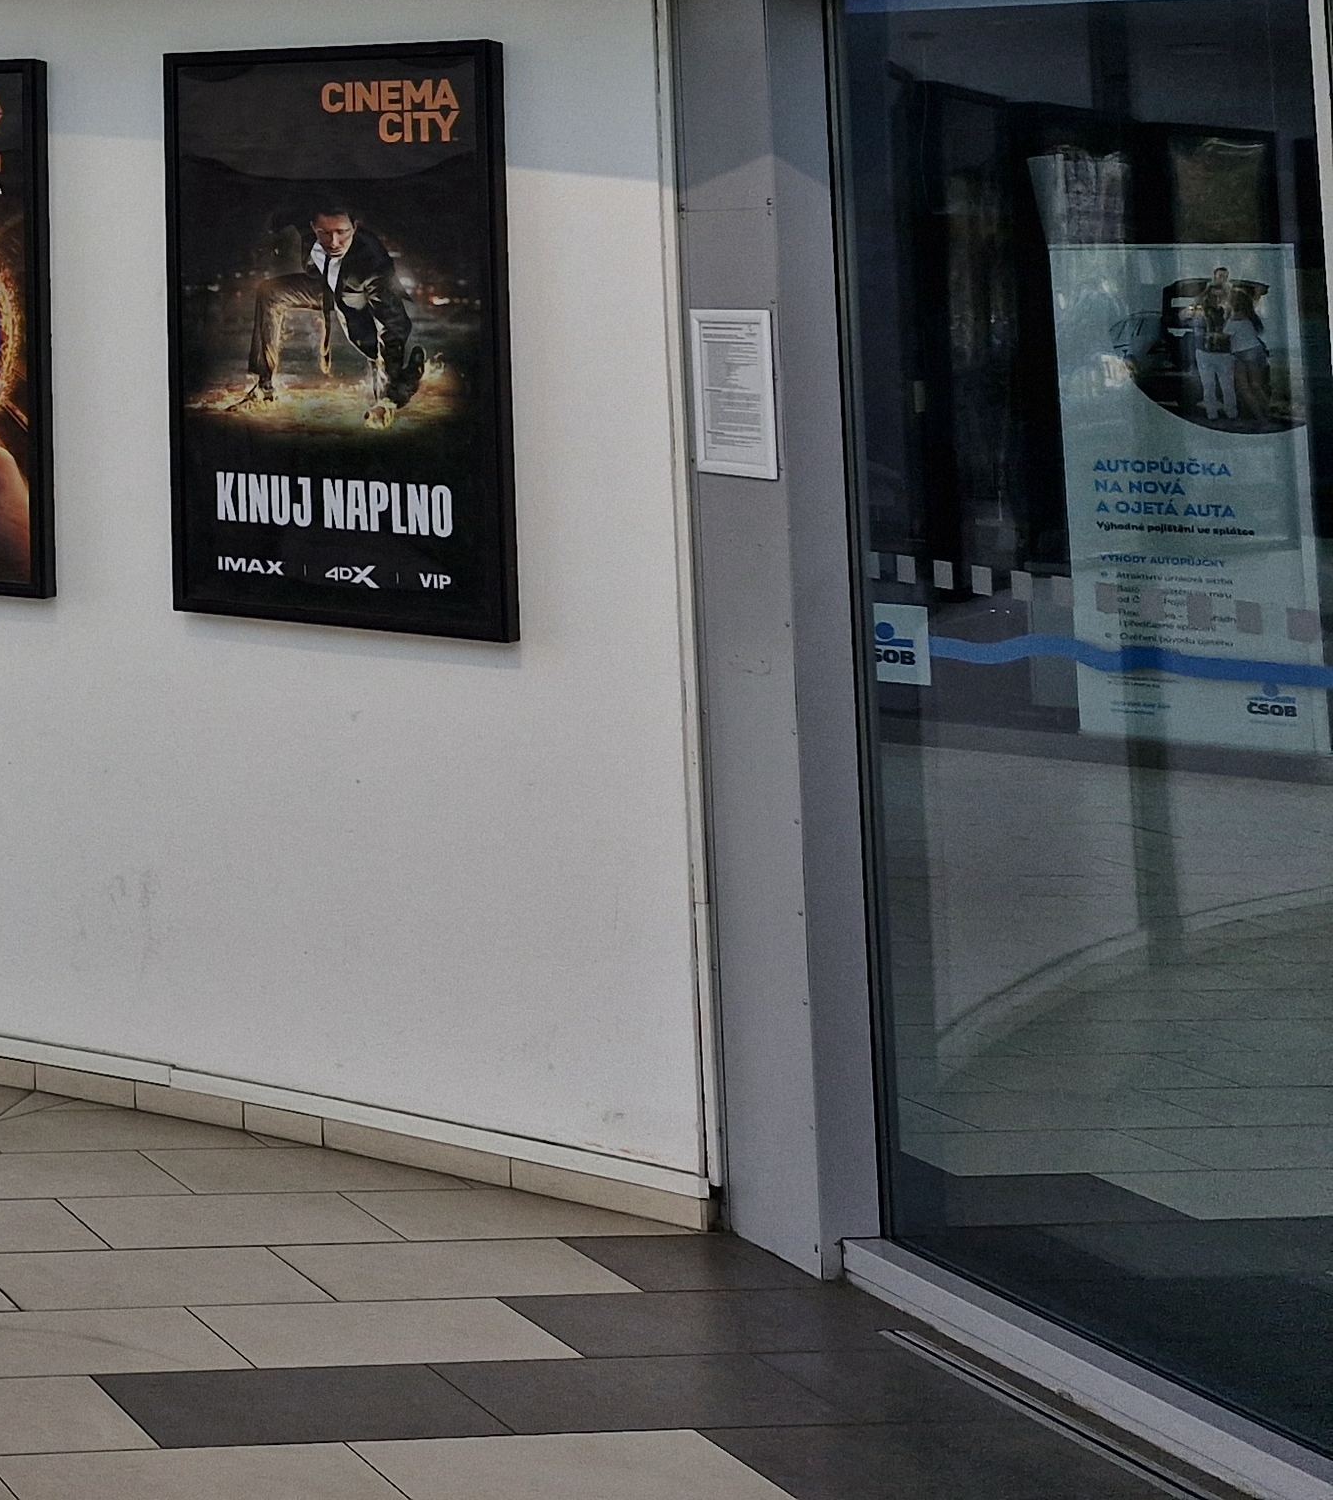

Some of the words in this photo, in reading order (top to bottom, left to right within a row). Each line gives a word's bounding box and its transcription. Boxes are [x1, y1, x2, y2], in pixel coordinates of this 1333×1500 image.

[321, 78, 460, 113] CINEMA
[378, 110, 460, 143] CITY
[1093, 456, 1232, 478] AUTOPŮJČKA
[1094, 479, 1123, 494] NA
[1129, 478, 1185, 495] NOVÁ
[216, 471, 312, 528] KINUJ
[323, 477, 453, 538] NAPLNO
[1096, 500, 1110, 514] A
[1115, 499, 1178, 516] OJETÁ
[1184, 503, 1236, 518] AUTA
[217, 556, 285, 576] IMAX
[324, 565, 380, 589] 4DX
[418, 572, 452, 590] VIP
